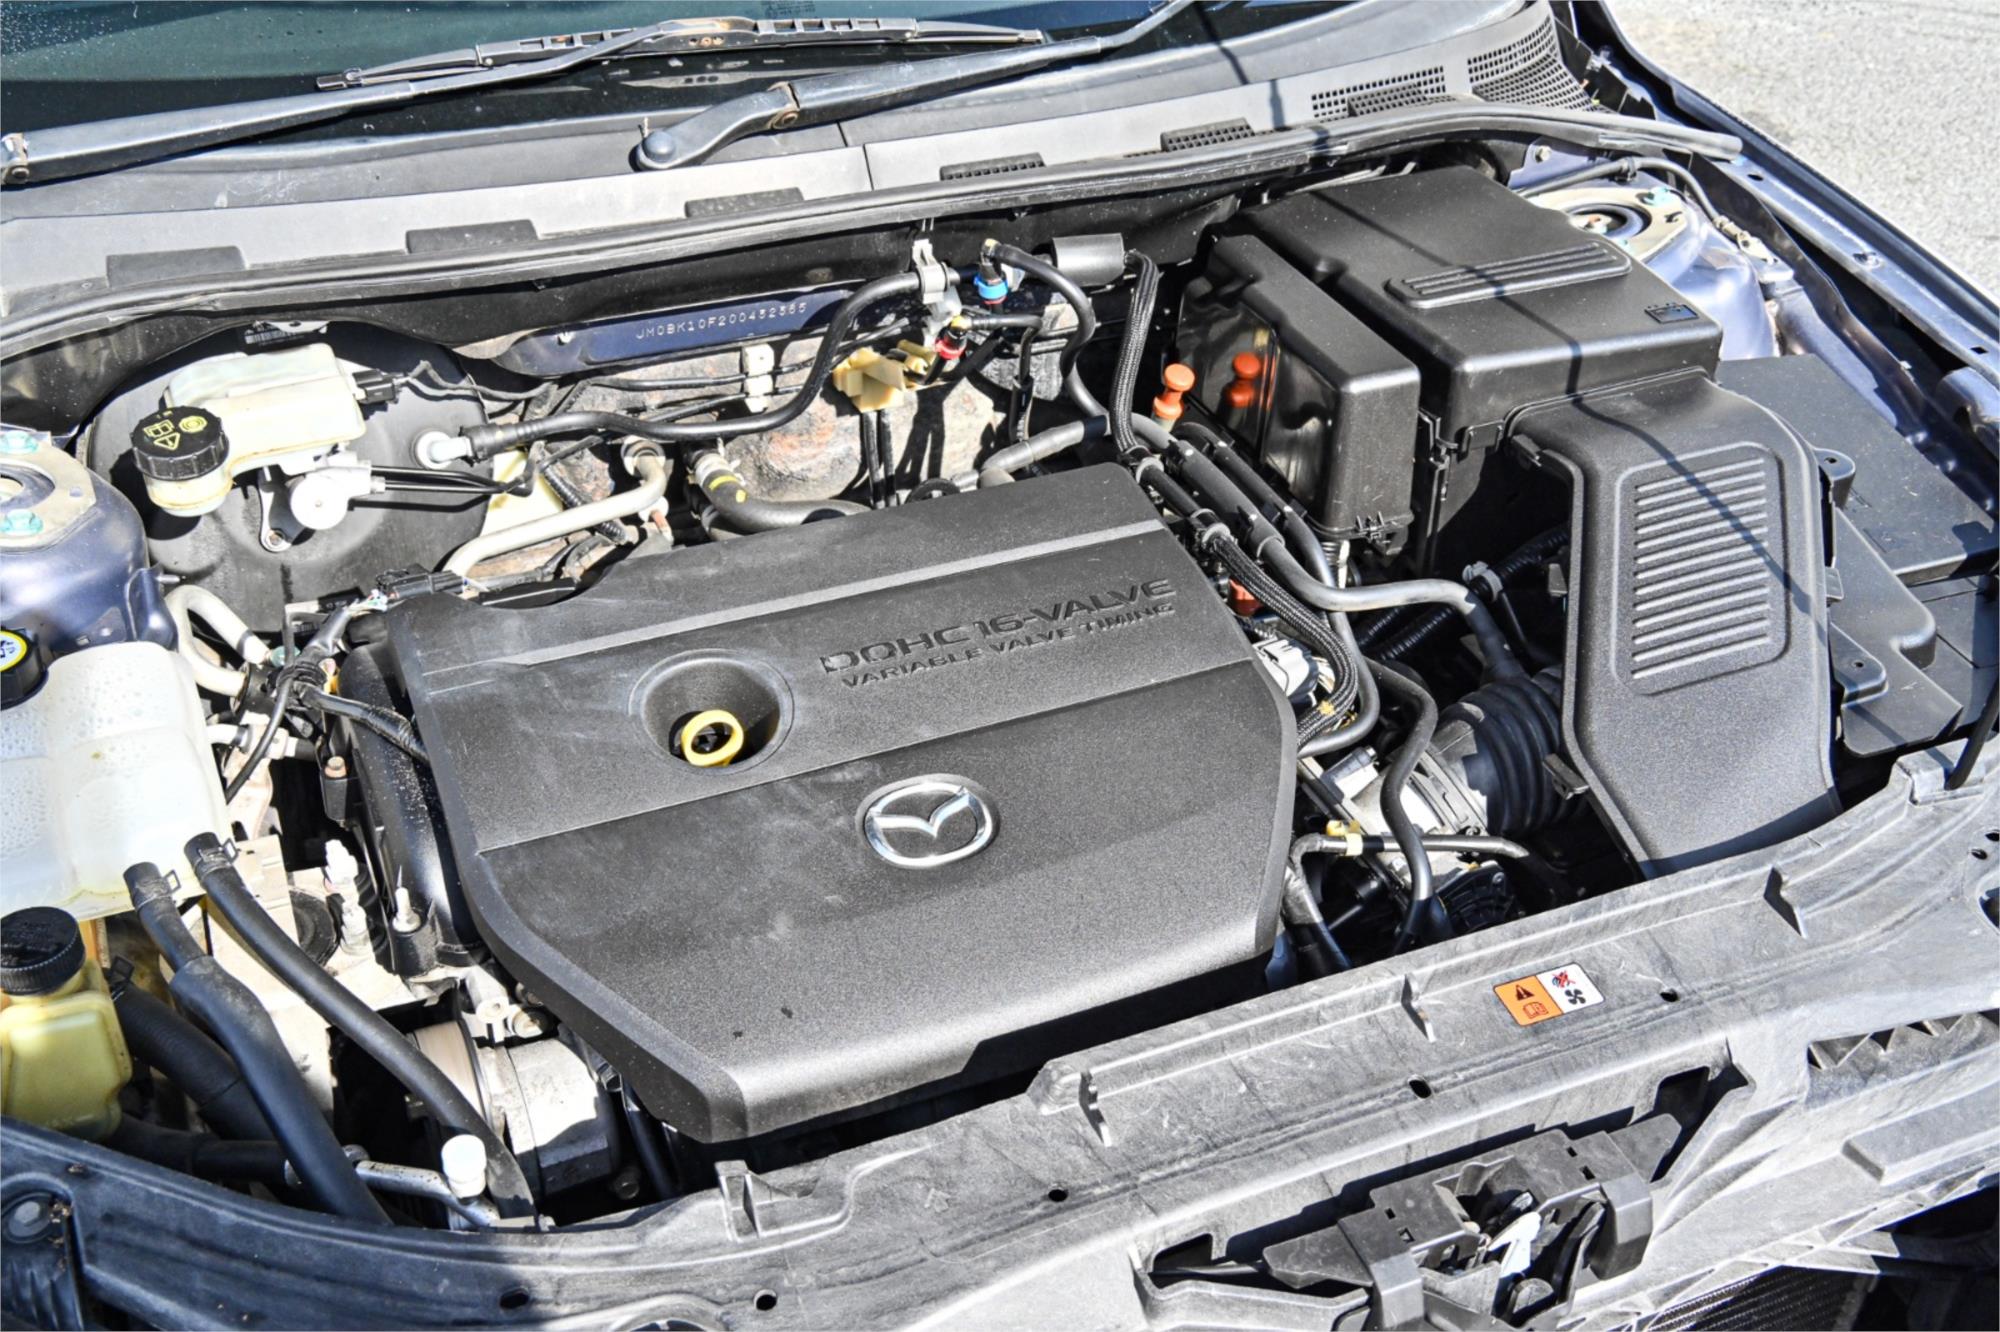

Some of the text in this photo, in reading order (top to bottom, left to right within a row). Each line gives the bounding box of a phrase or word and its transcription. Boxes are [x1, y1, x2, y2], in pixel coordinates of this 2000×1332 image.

[819, 578, 1177, 673] DOHC 16-VALVE
[841, 602, 1177, 688] VARIABLE VALVE TIMING
